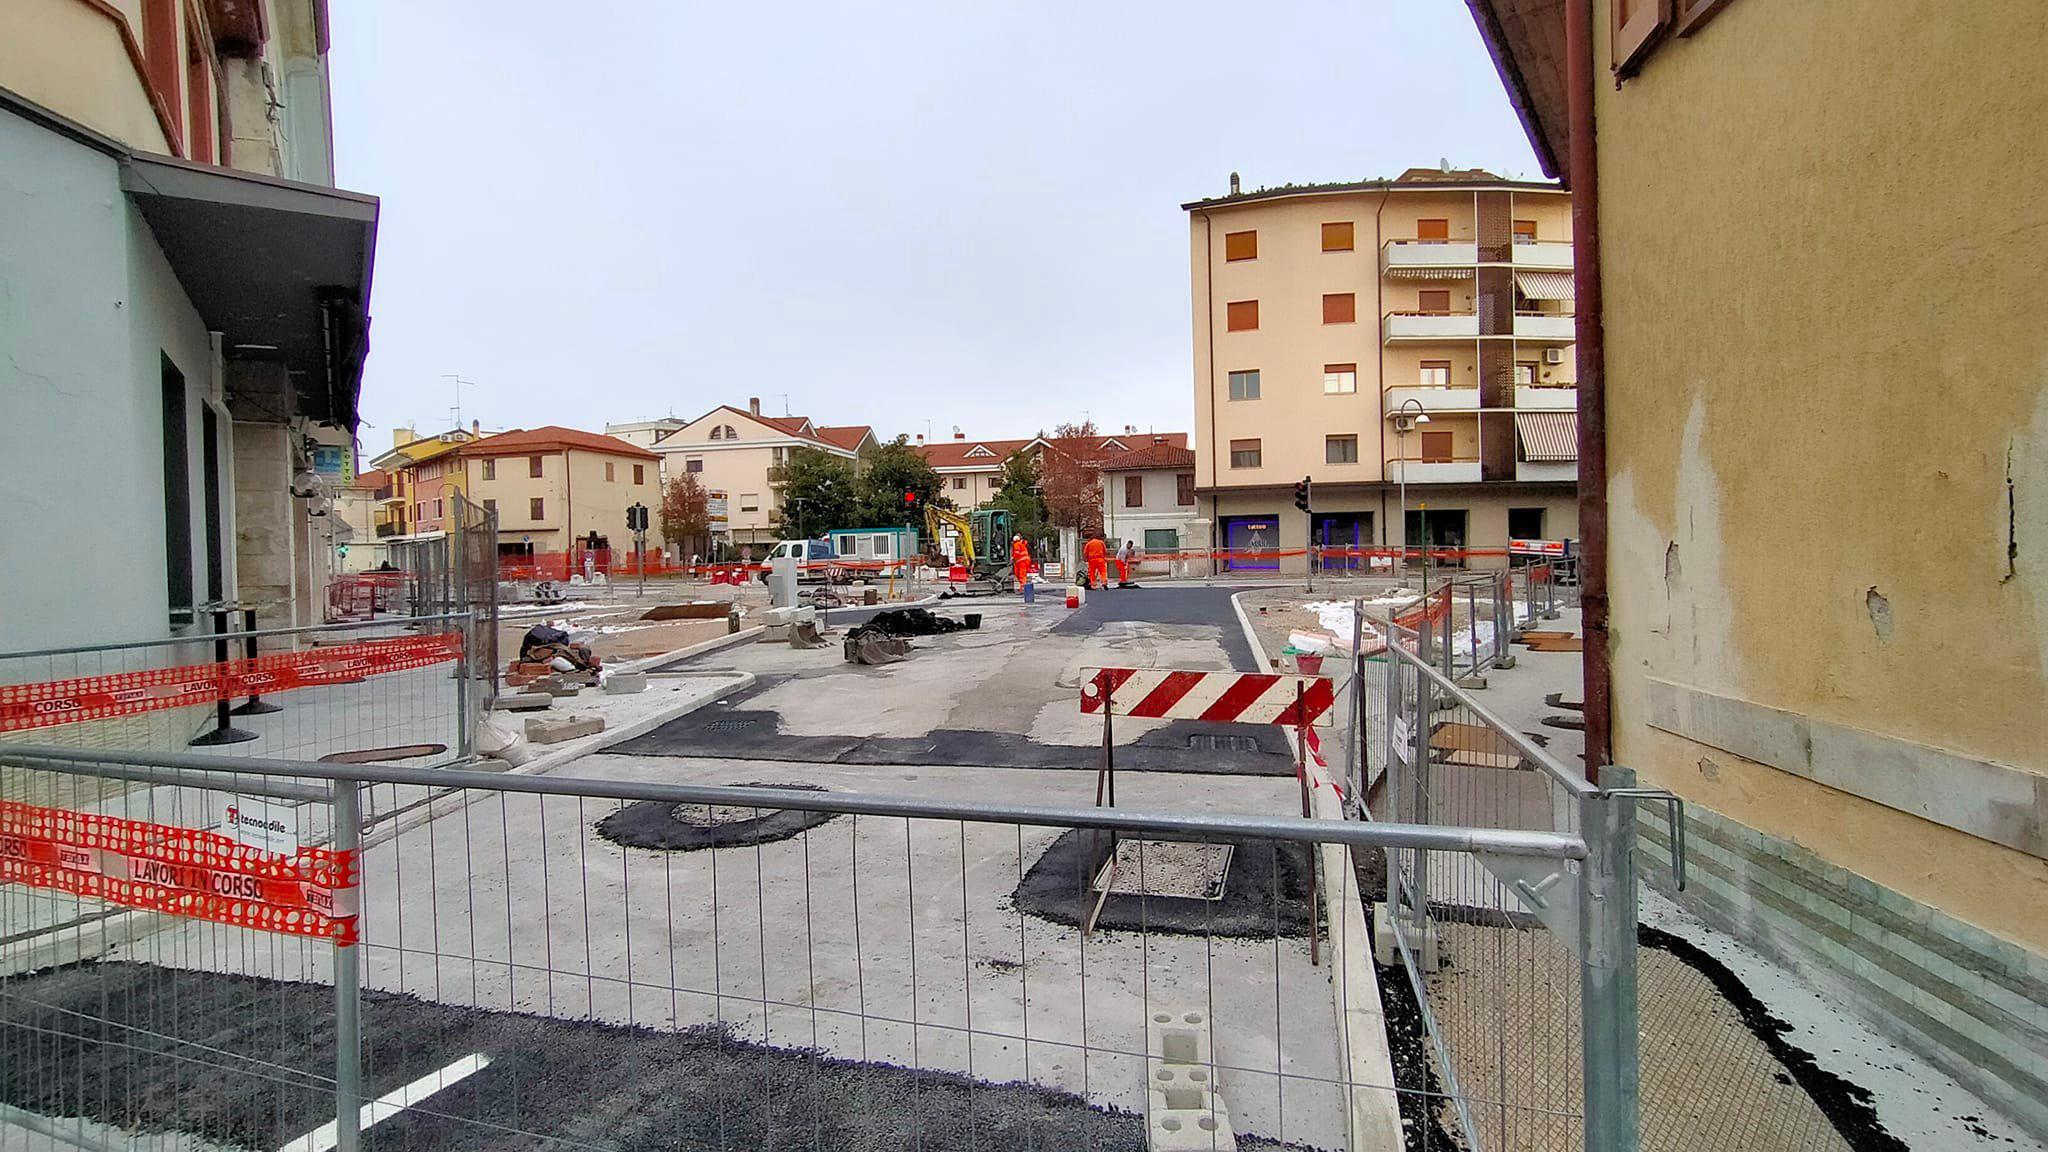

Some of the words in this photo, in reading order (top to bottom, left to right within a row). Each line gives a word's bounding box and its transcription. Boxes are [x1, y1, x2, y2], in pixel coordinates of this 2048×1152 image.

[389, 652, 414, 662] CORSO
[241, 672, 276, 684] CORSO
[34, 698, 83, 713] CORSO
[240, 814, 286, 833] tecnoedile
[134, 860, 184, 886] LAVORI
[191, 867, 207, 890] IN
[212, 873, 263, 898] CORSO
